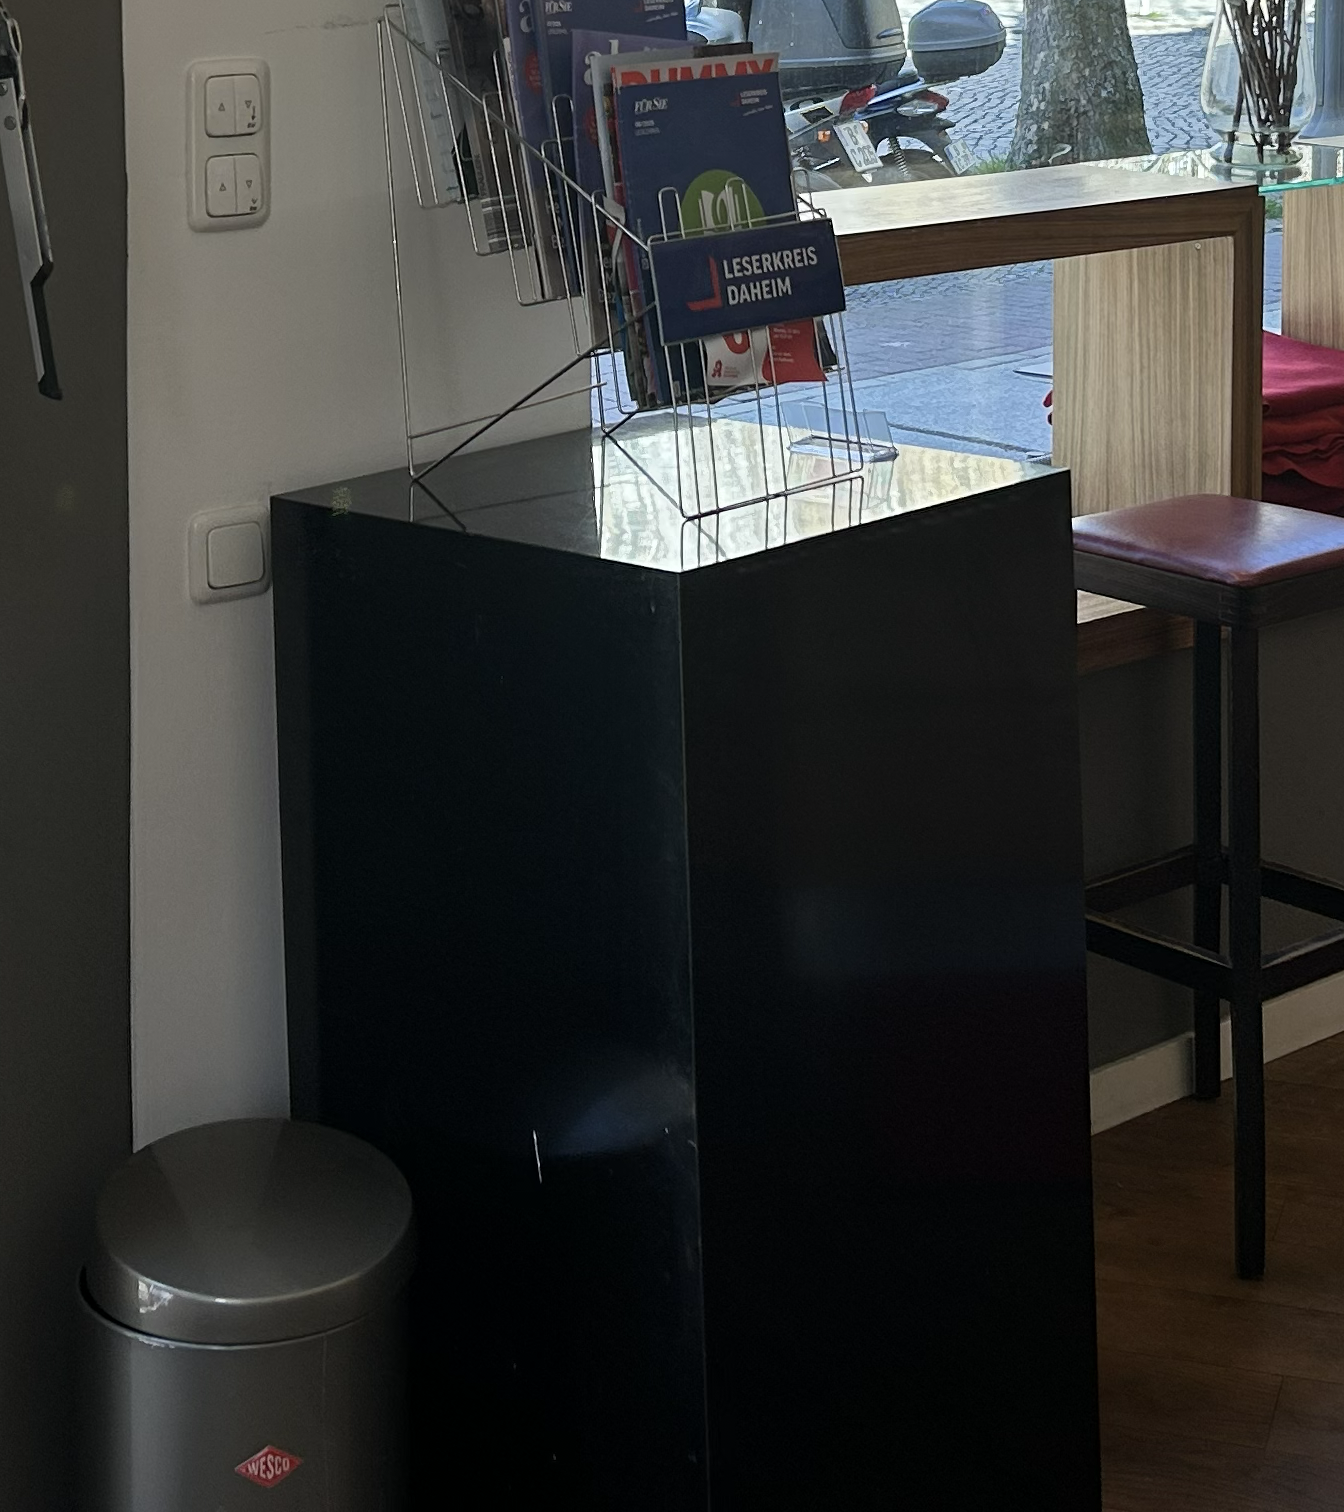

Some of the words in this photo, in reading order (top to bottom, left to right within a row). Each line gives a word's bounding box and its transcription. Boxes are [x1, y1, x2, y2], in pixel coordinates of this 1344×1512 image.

[723, 246, 818, 279] LESERKREIS
[727, 276, 792, 306] DAHEIM
[247, 1454, 291, 1480] WESCO
